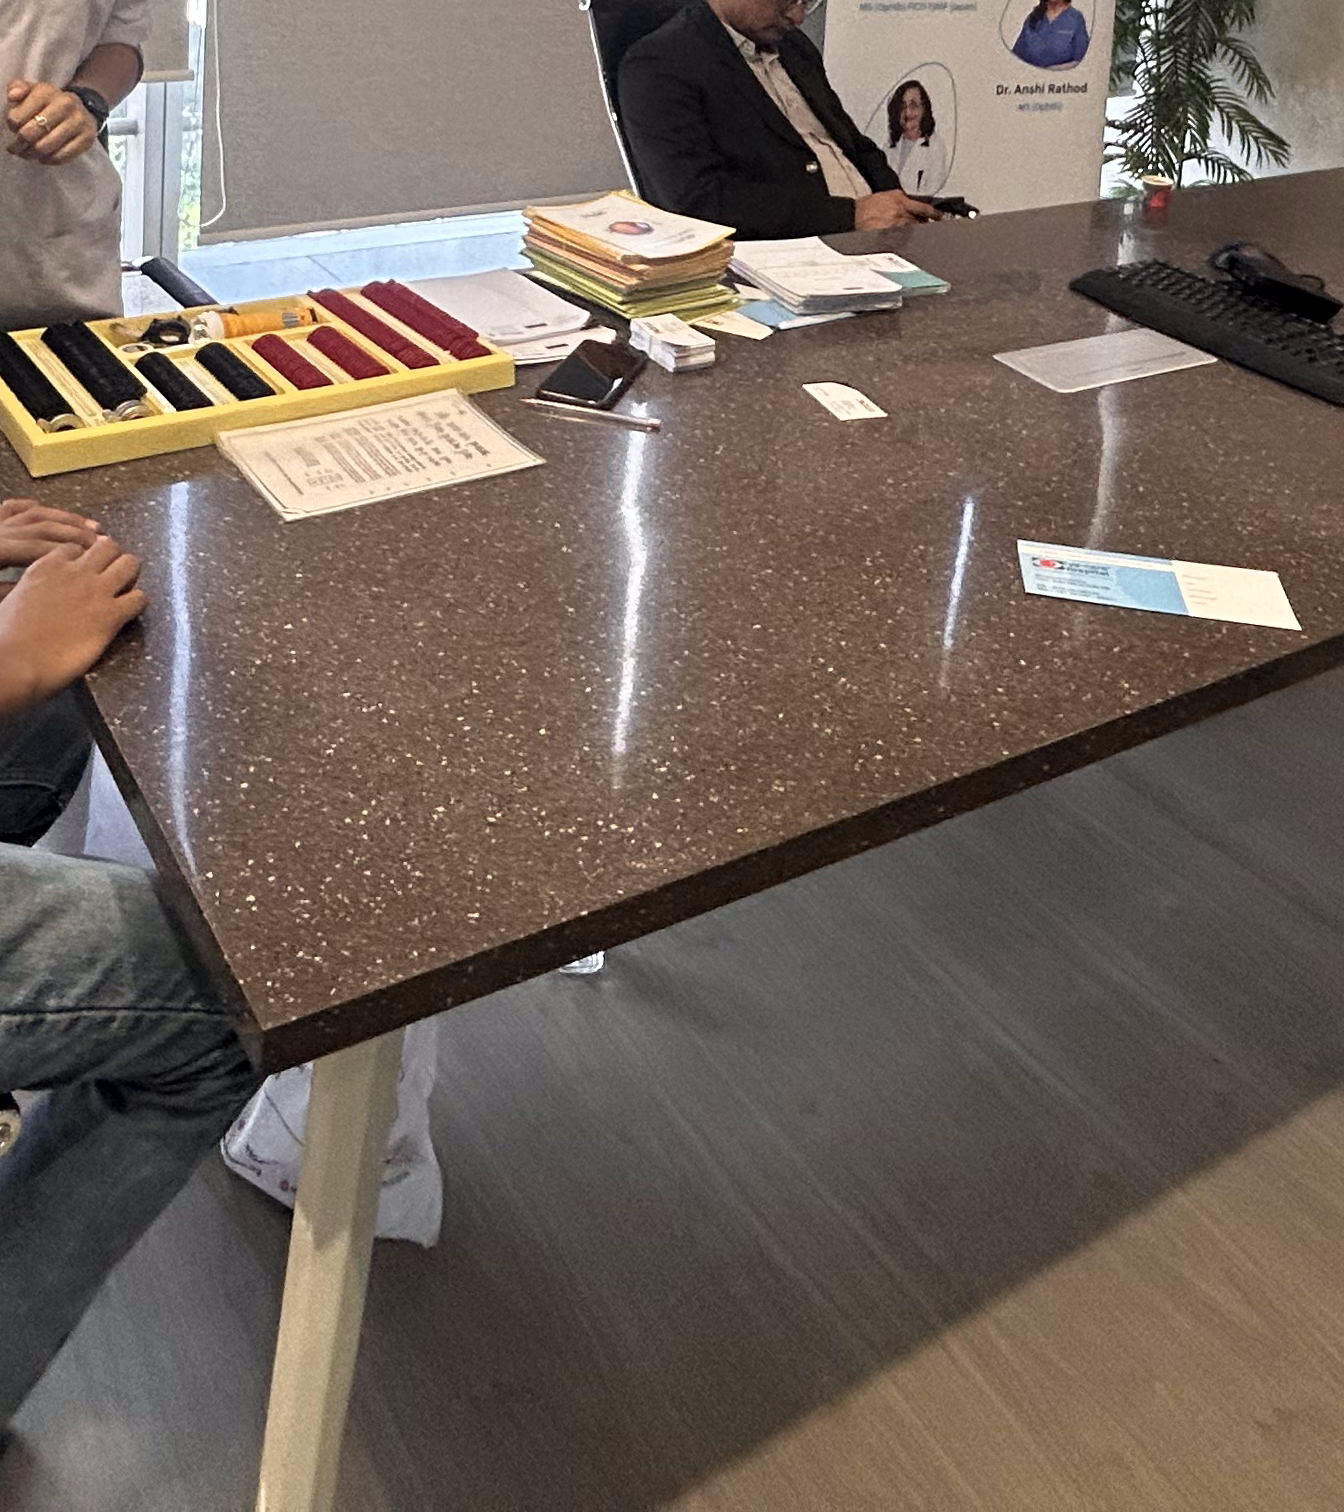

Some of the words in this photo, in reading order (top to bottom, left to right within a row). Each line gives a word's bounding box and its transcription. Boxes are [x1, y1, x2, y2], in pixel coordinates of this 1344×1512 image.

[996, 84, 1012, 96] Dr.
[1014, 82, 1046, 95] Anshi
[1047, 81, 1088, 94] Rathod
